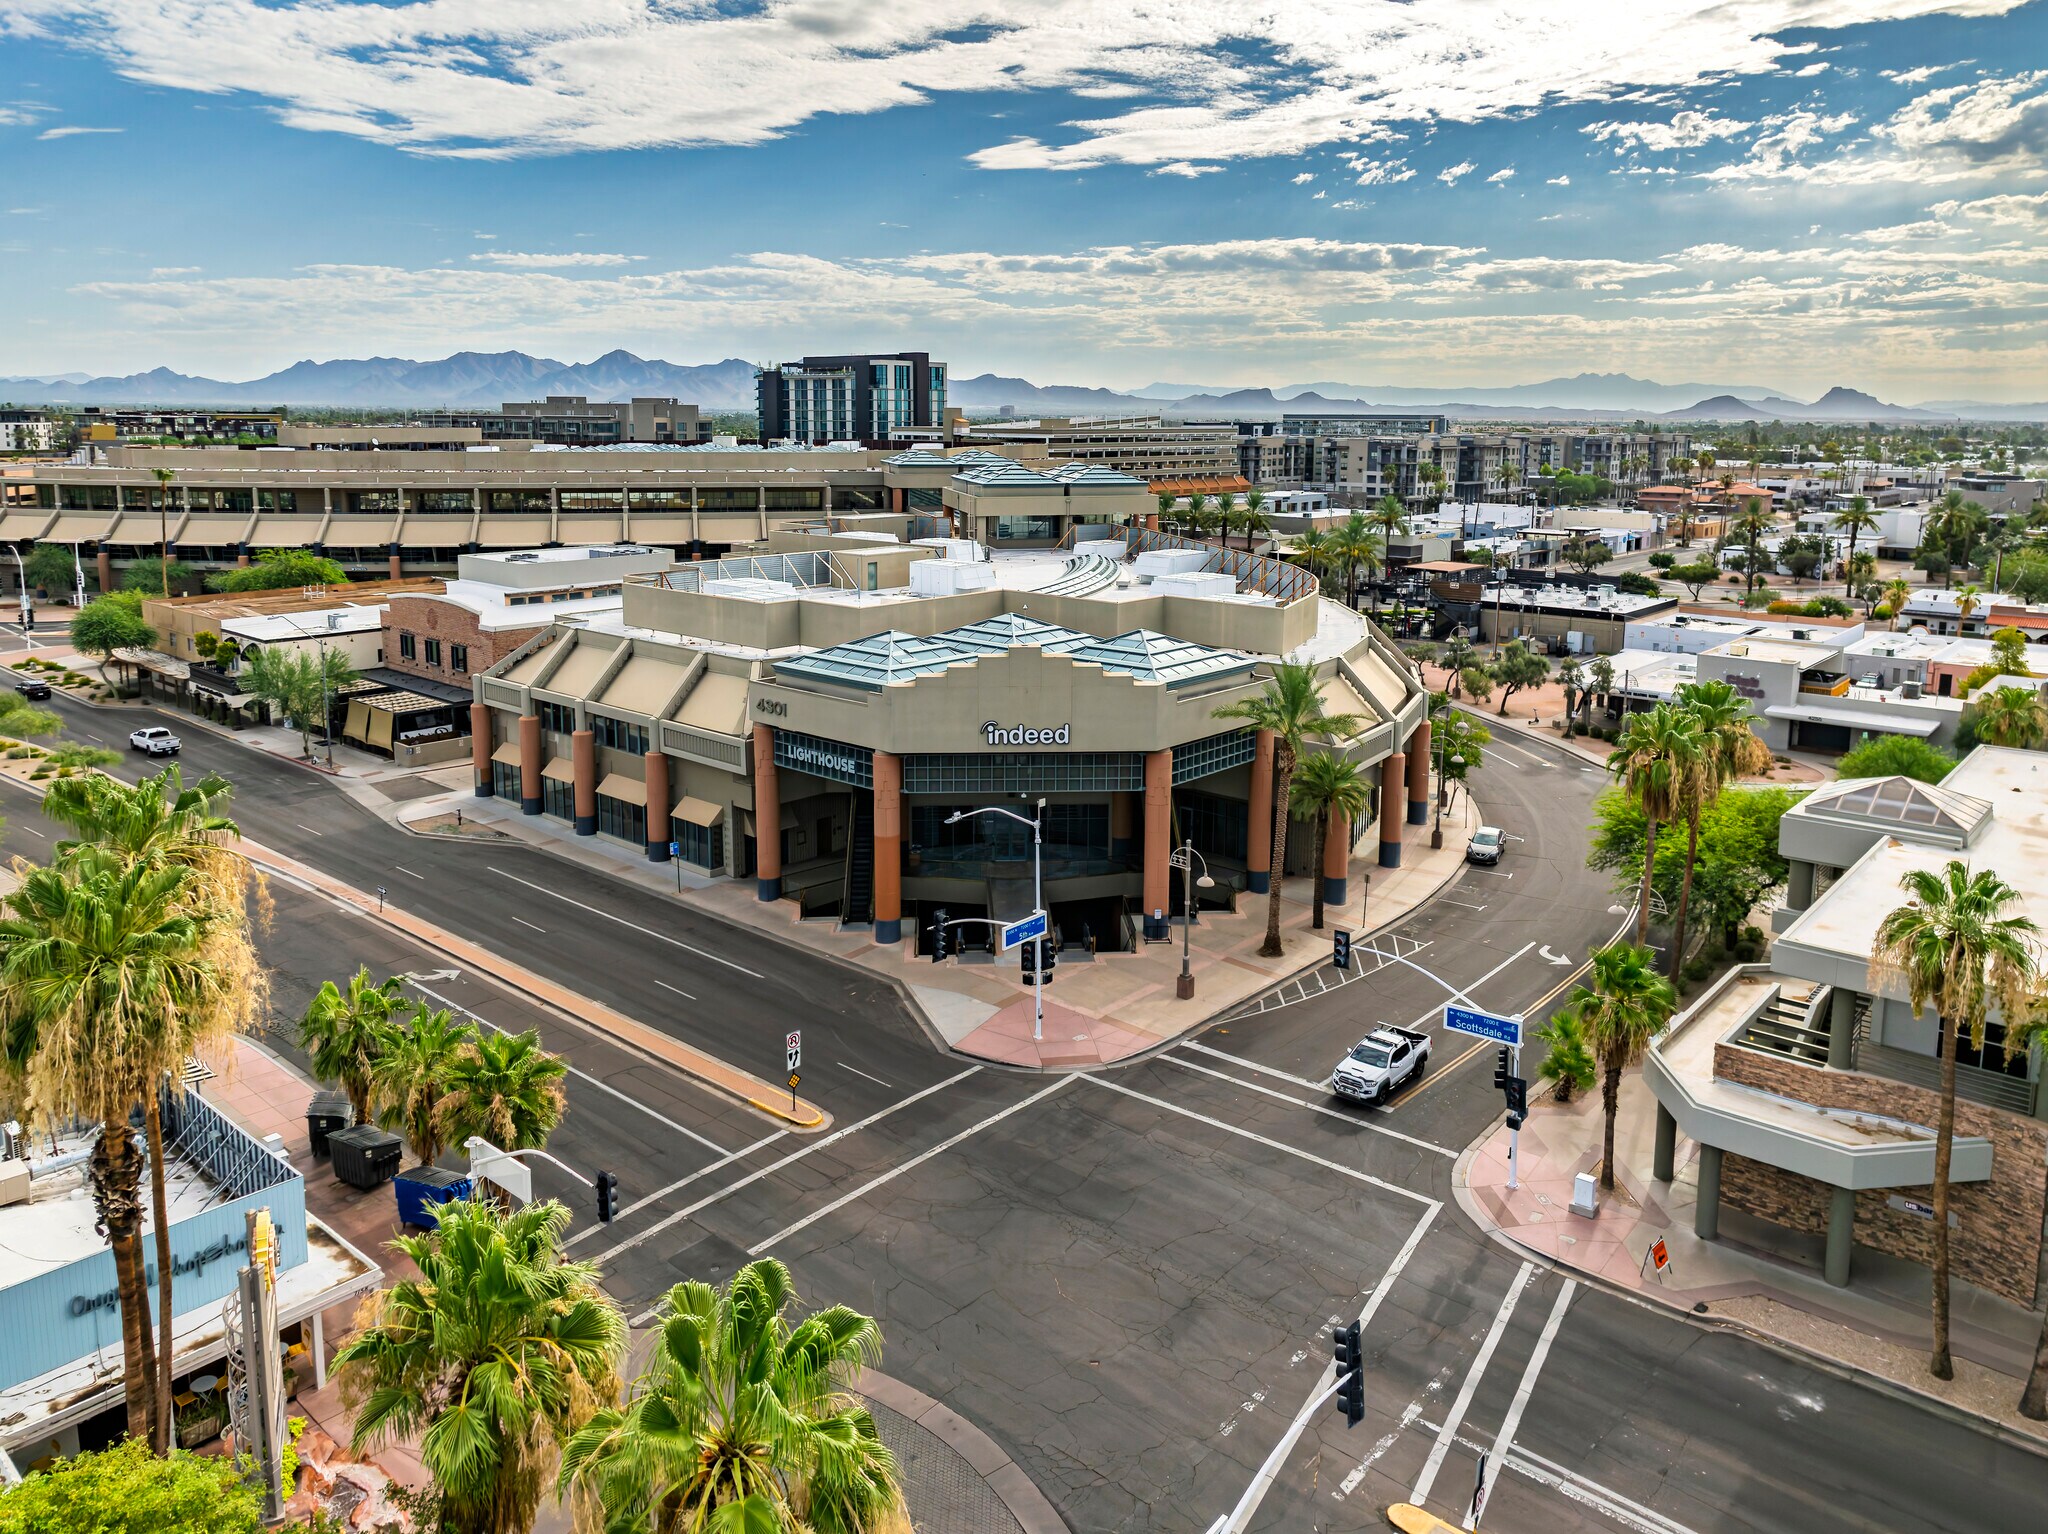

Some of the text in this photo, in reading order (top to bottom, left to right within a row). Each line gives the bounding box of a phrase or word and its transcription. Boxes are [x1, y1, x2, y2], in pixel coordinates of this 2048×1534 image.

[756, 699, 787, 717] 4301
[984, 721, 1070, 745] indeed
[788, 745, 855, 773] LIGHTHOUSE
[1455, 1019, 1503, 1039] Scottsdale
[1483, 1018, 1496, 1026] 7200
